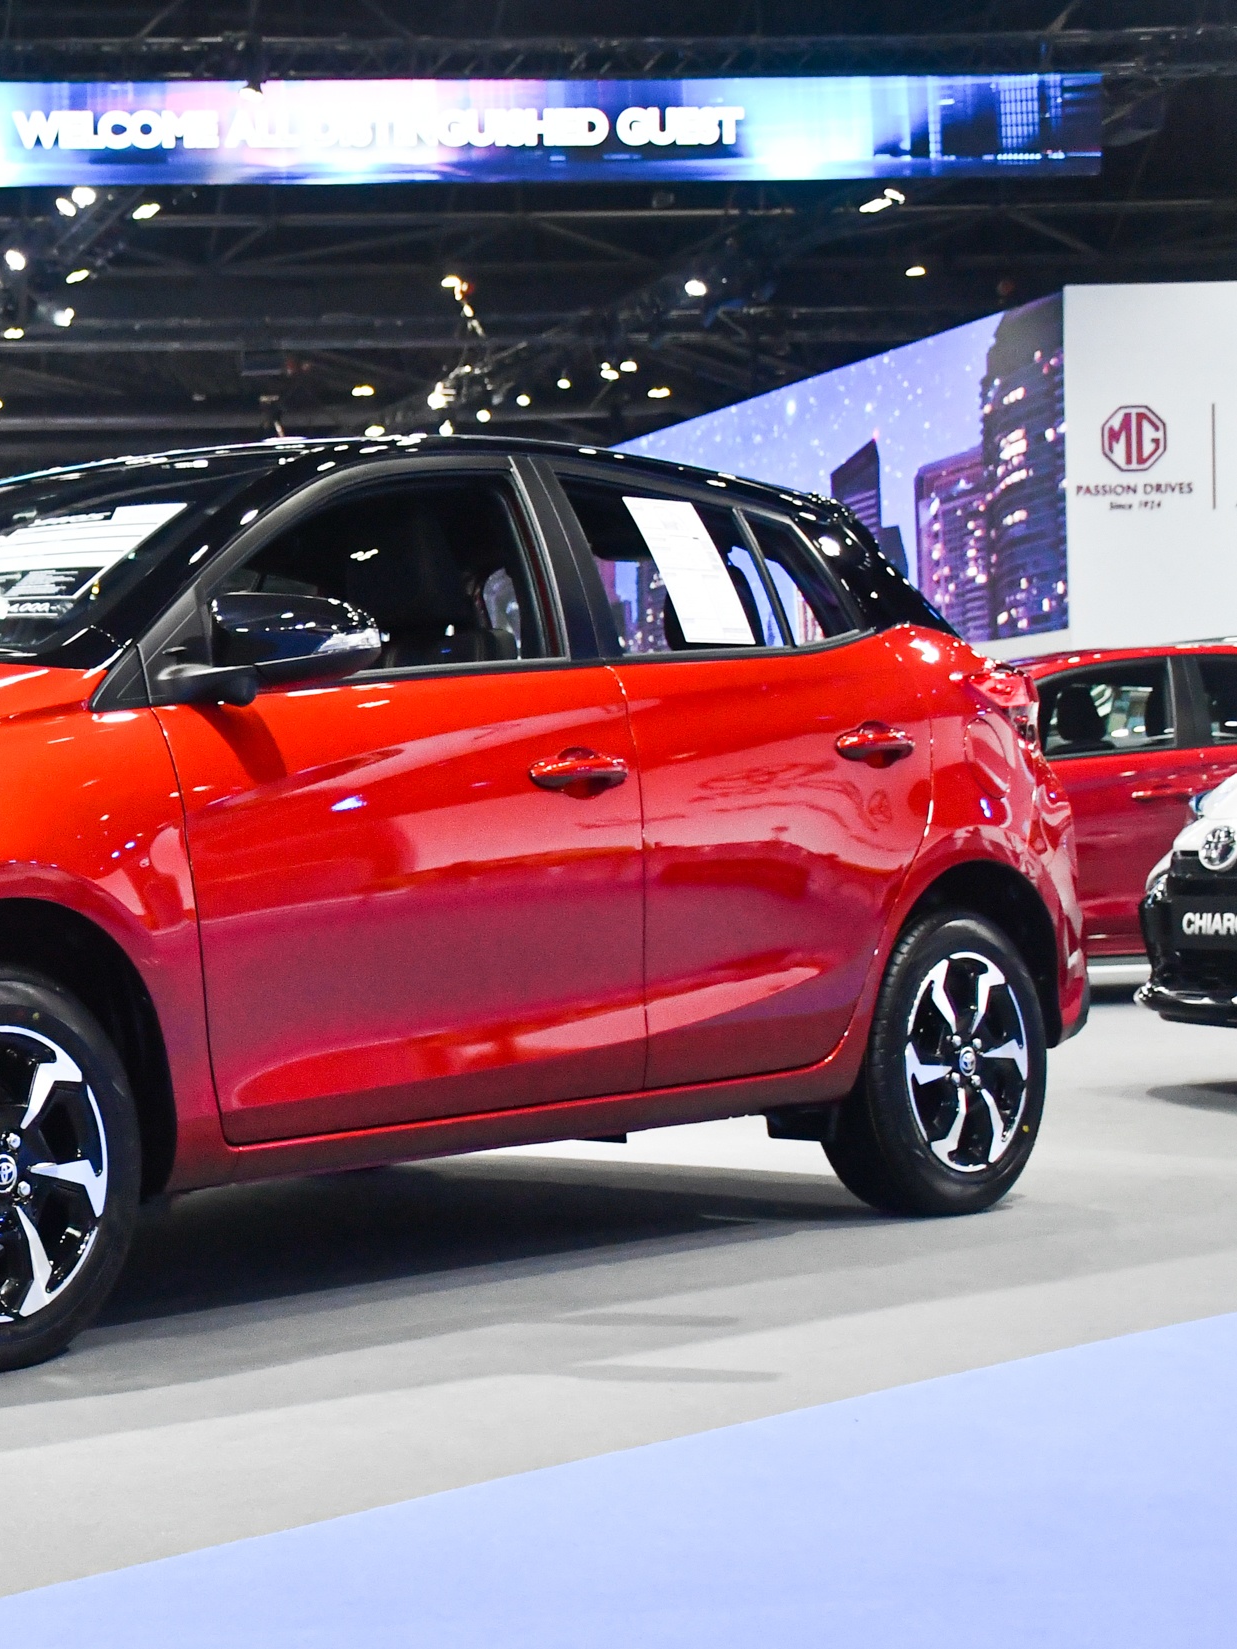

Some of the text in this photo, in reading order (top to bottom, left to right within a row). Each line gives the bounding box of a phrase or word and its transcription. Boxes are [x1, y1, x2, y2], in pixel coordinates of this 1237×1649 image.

[12, 109, 220, 150] WELCOME
[224, 109, 301, 149] ALL
[615, 106, 745, 146] GUEST
[1107, 411, 1161, 466] MG
[1076, 482, 1194, 496] PASSION DRIVES
[1182, 912, 1237, 935] CHIAR
